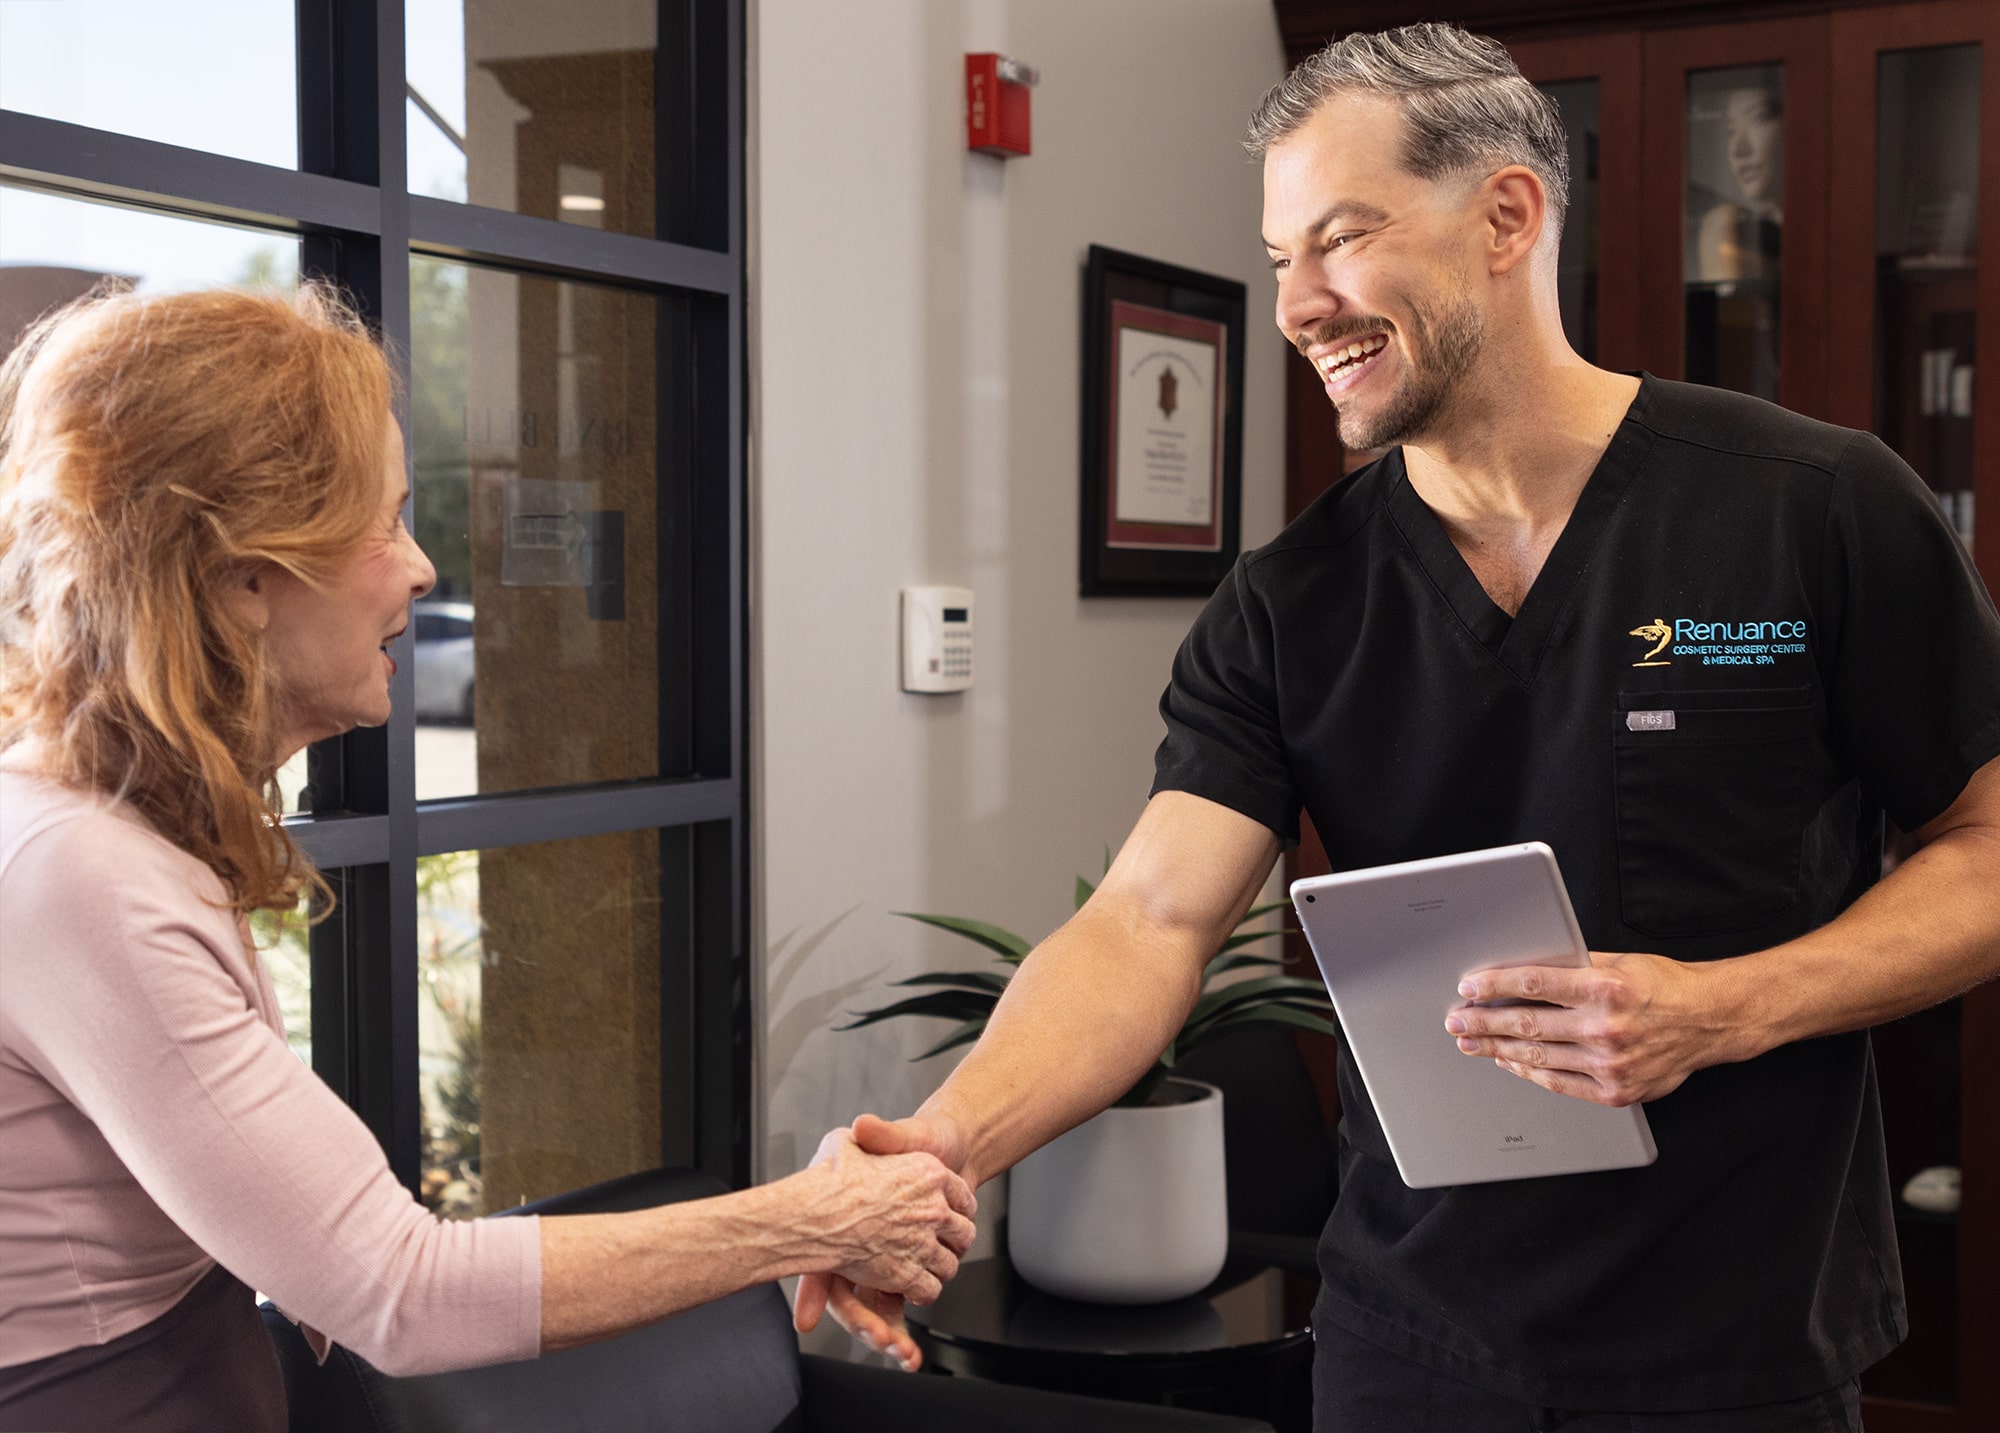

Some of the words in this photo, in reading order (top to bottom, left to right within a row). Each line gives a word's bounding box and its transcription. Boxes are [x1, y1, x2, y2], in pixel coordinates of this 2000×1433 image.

[1675, 619, 1807, 641] Renuance
[1673, 645, 1723, 656] COSMETIC
[1725, 644, 1770, 655] SURGERY
[1772, 643, 1806, 654] CENTER
[1702, 656, 1711, 666] &
[1711, 655, 1753, 665] MEDICAL
[1755, 655, 1775, 665] SPA
[1641, 715, 1663, 725] FIGS
